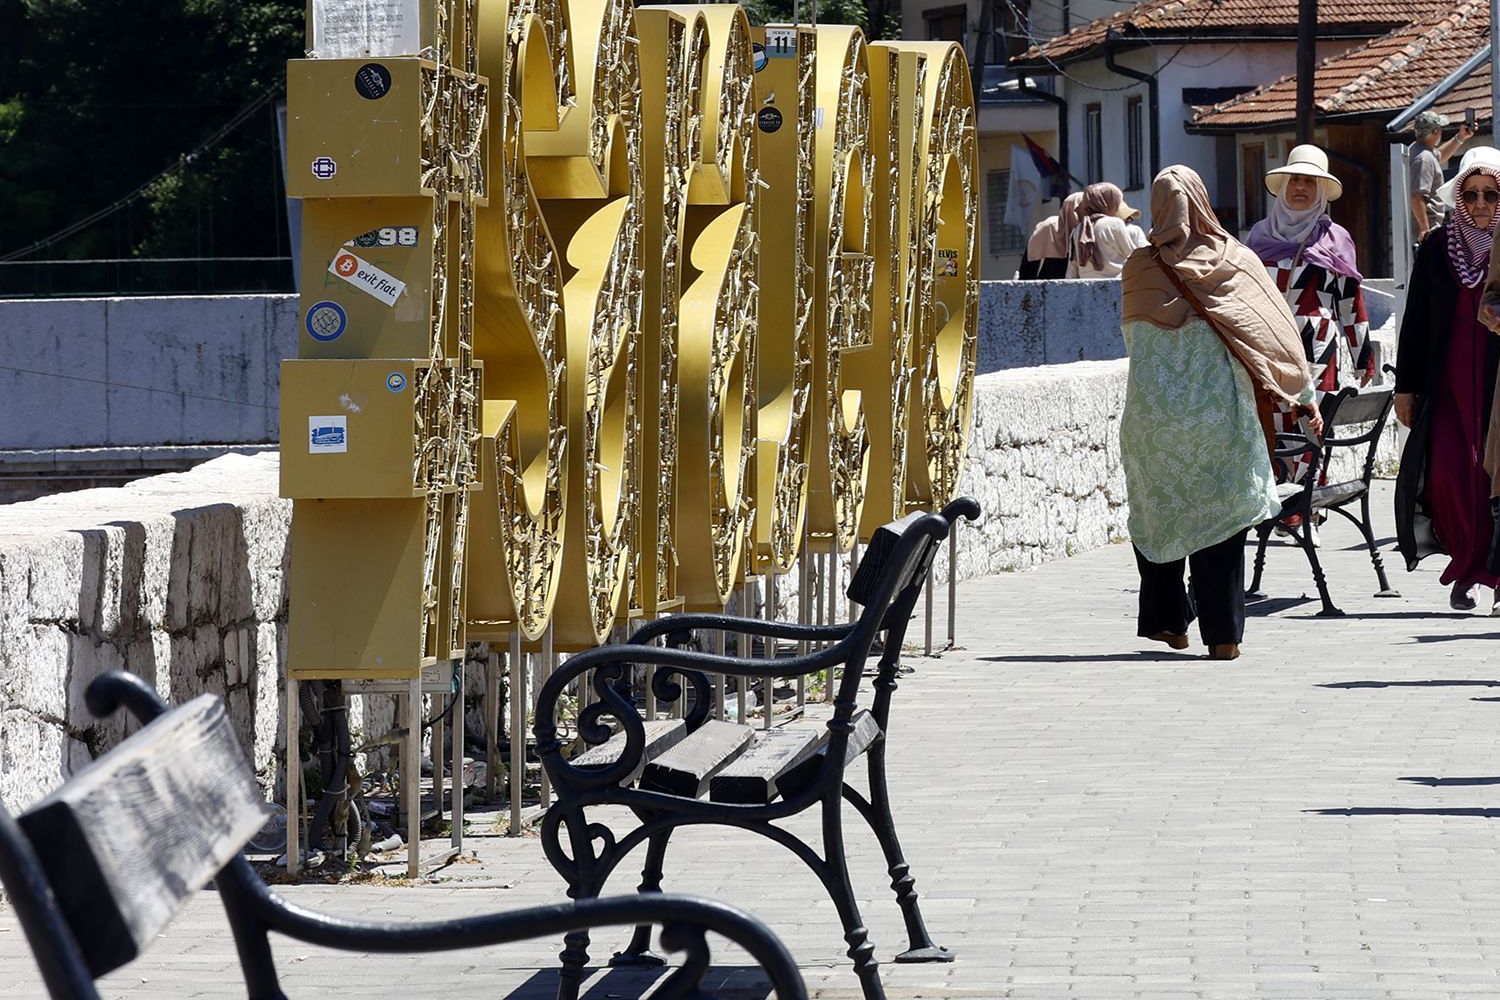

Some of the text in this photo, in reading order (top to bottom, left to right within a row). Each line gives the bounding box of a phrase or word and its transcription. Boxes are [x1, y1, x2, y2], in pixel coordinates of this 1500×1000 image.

[774, 35, 788, 54] 11
[378, 227, 417, 246] 98
[938, 249, 958, 258] ELVIS
[357, 270, 396, 298] exit fiat.
